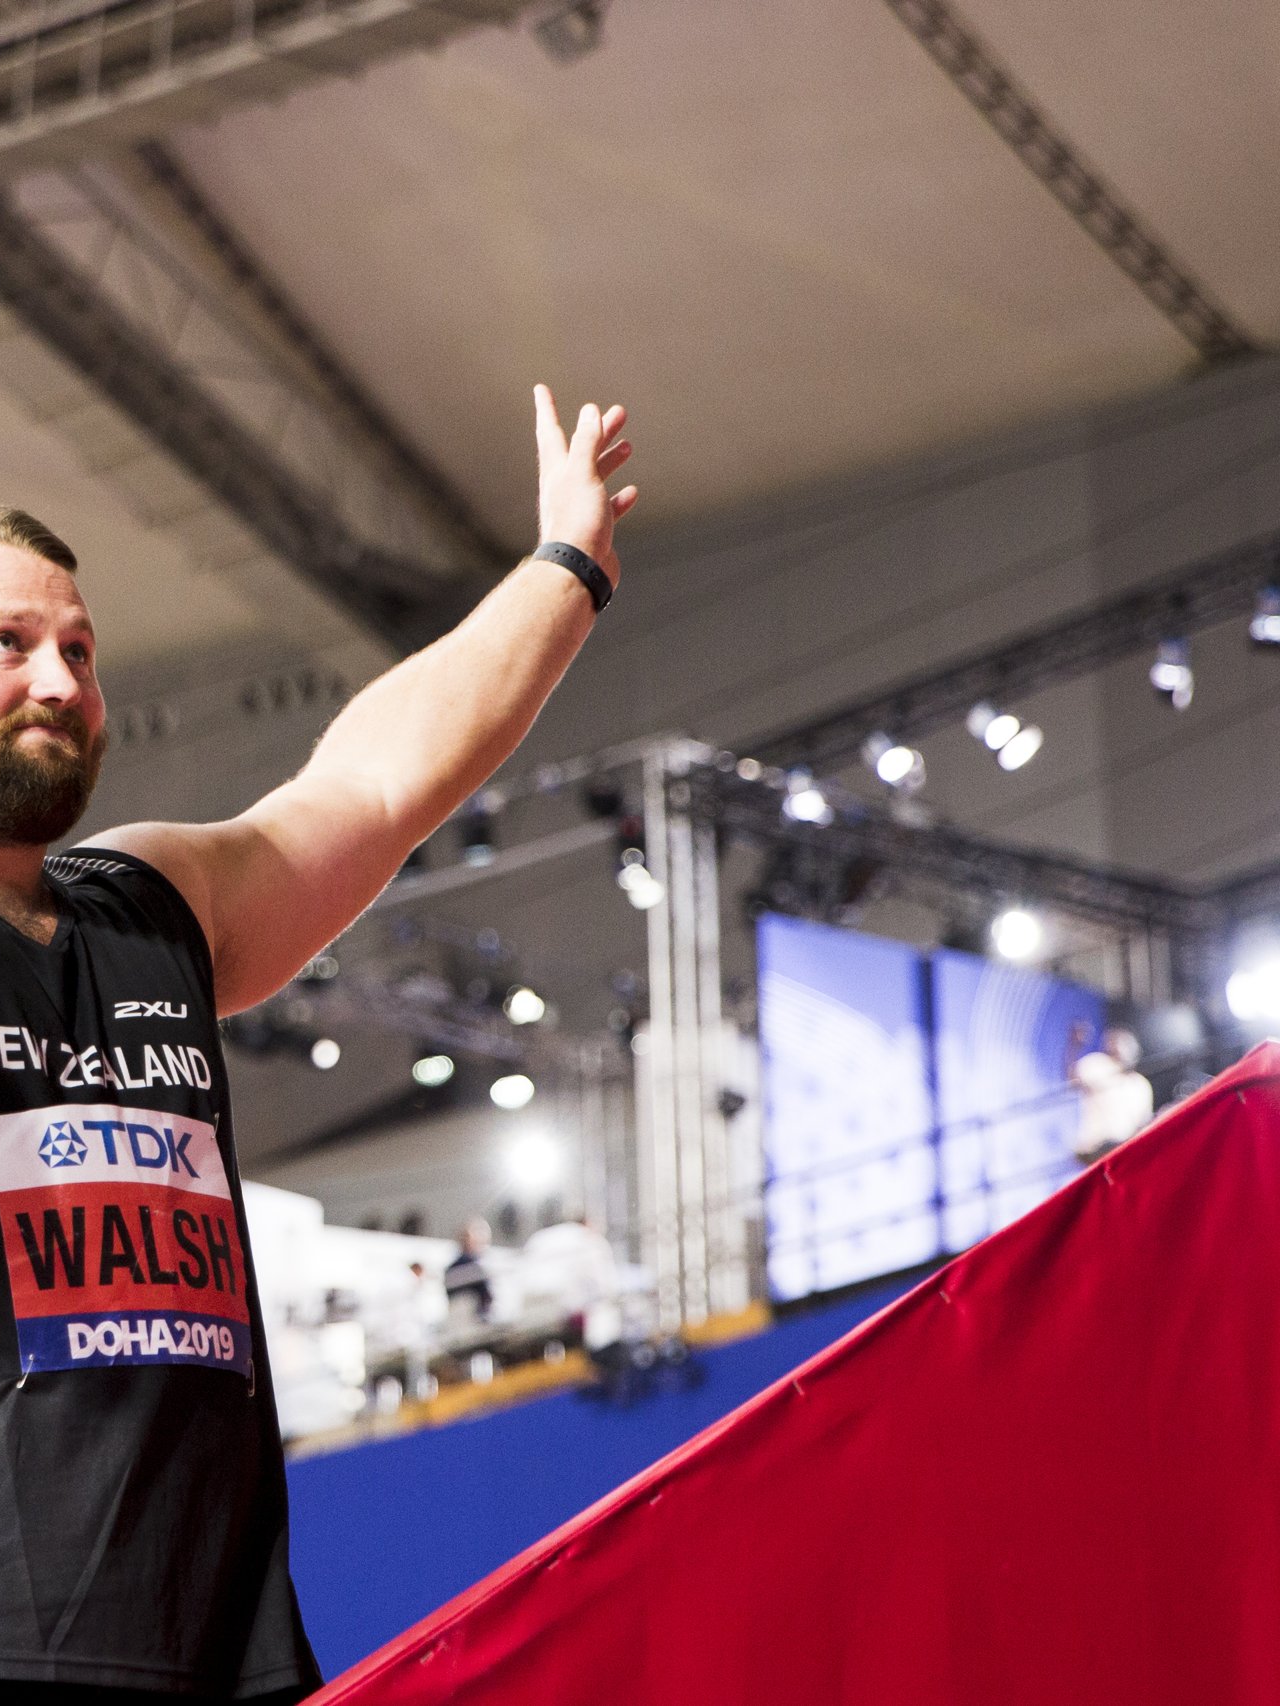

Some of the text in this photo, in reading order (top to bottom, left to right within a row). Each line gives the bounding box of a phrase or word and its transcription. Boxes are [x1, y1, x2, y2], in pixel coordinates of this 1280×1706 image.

[114, 1000, 187, 1019] 2XU
[60, 1044, 212, 1090] ZEALAND
[83, 1120, 200, 1179] TDK
[15, 1205, 237, 1296] WALSH
